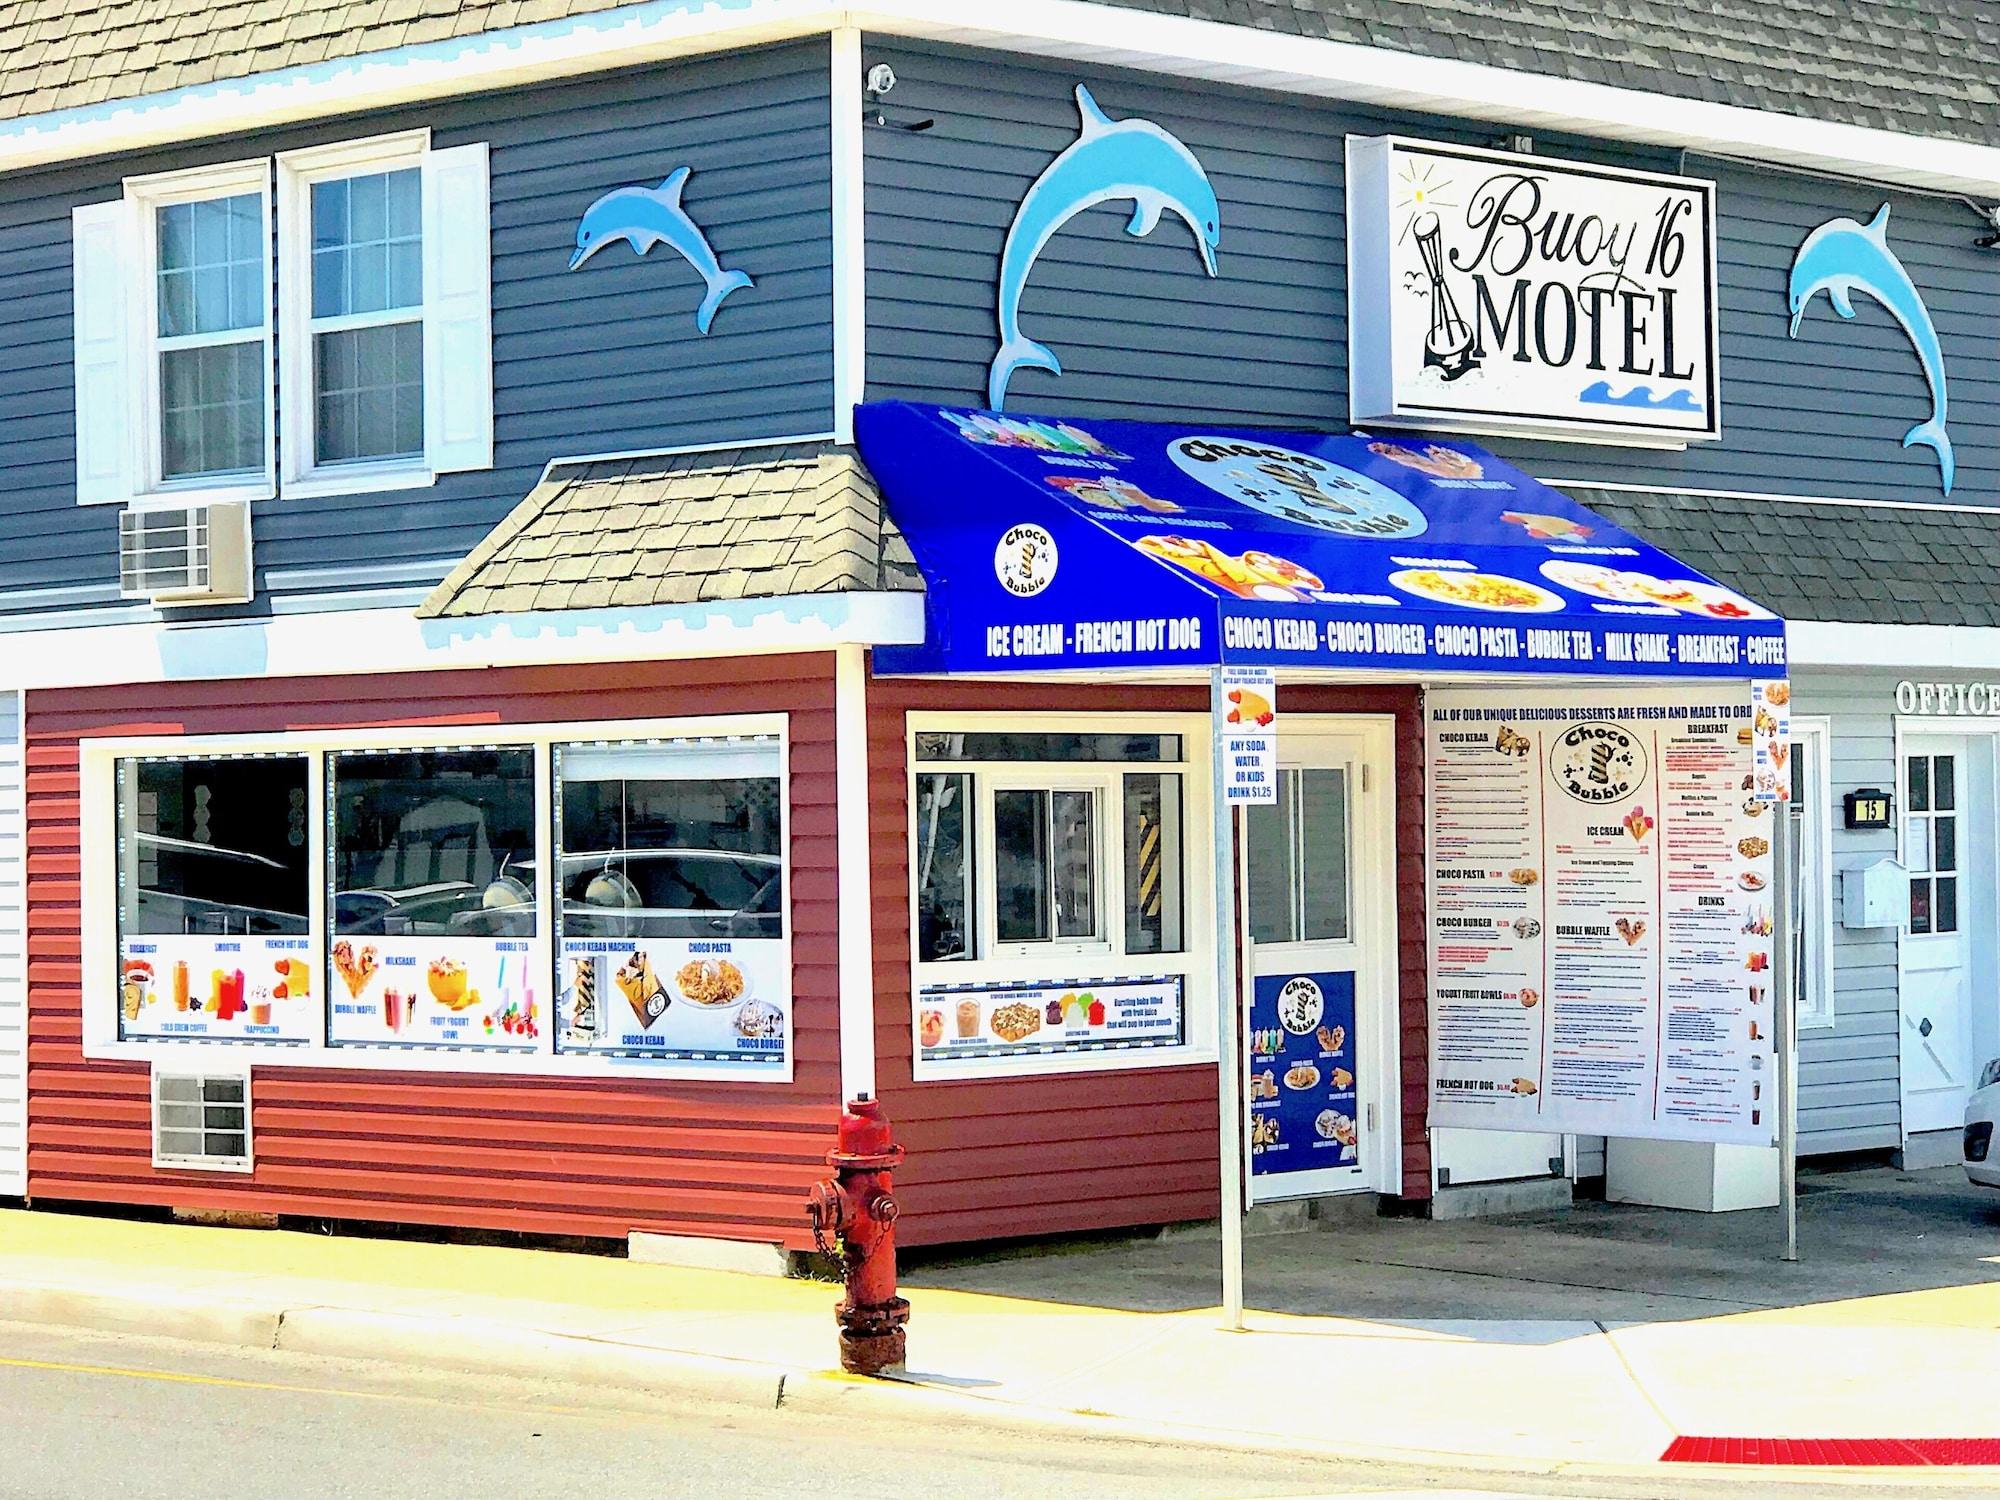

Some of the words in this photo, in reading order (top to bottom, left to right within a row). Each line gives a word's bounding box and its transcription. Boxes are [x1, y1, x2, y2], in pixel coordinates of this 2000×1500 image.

[1449, 173, 1646, 292] Buoy
[1645, 197, 1692, 278] 16
[1471, 273, 1695, 381] MOTEL
[1180, 440, 1327, 472] Choco
[1005, 528, 1047, 546] Choco
[1006, 576, 1046, 594] Bubble
[986, 625, 1011, 657] ICE
[1013, 623, 1063, 656] CREAM
[1075, 620, 1133, 654] FRENCH
[1135, 618, 1167, 652] HOT
[1168, 616, 1201, 650] DOG
[1224, 616, 1273, 650] CHOCO
[1273, 618, 1319, 651] KEBAB
[1327, 621, 1373, 653] CHOCO
[1374, 623, 1427, 655] BURGER
[1435, 624, 1478, 656] CHOCO
[1480, 627, 1519, 658] PASTA
[1527, 629, 1571, 660] BUBBLE
[1572, 631, 1594, 661] TEA
[1604, 632, 1634, 662] MILK
[1634, 633, 1671, 663] SHAKE
[1677, 634, 1740, 664] BREAKFAST
[1746, 636, 1785, 665] COFFEE
[1895, 680, 2000, 715] OFFICE
[1433, 708, 1449, 721] ALL
[1450, 708, 1460, 721] OF
[1462, 708, 1482, 721] OUR
[1484, 708, 1518, 722] UNIQUE
[1519, 707, 1568, 721] DELICIOUS
[1569, 706, 1616, 720] DESSERTS
[1617, 706, 1635, 720] ARE
[1637, 706, 1667, 720] FRESH
[1668, 706, 1688, 719] AND
[1690, 705, 1717, 719] MADE
[1719, 705, 1731, 718] TO
[1687, 723, 1729, 734] BREAKFAST
[1439, 732, 1465, 743] CHOCO
[1465, 732, 1489, 743] KEBAB
[1565, 726, 1630, 747] Choco
[1230, 740, 1244, 751] ANY
[1235, 771, 1246, 782] OR
[1247, 771, 1265, 782] KIDS
[1228, 786, 1250, 798] DRINK
[1568, 781, 1629, 800] Bubble
[1865, 801, 1877, 821] 15
[1587, 826, 1599, 836] ICE
[1599, 826, 1625, 836] CREAM
[1436, 869, 1462, 879] CHOCO
[1463, 869, 1486, 879] PASTA
[1698, 896, 1725, 906] DRINKS
[1436, 917, 1462, 927] CHOCO
[1463, 918, 1492, 927] BURGER
[1555, 925, 1583, 935] BUBBLE
[1584, 925, 1611, 936] WAFFLE
[495, 941, 517, 952] BUBBLE
[517, 941, 529, 952] TEA
[565, 941, 587, 952] CHOCO
[587, 941, 607, 952] KEBAB
[607, 942, 636, 952] MACHINE
[688, 942, 711, 953] CHOCO
[711, 942, 732, 953] PASTA
[1285, 981, 1316, 996] Choco
[622, 1034, 643, 1045] CHOCO
[644, 1035, 665, 1046] KEBAB
[736, 1038, 759, 1048] CHOCO
[1436, 1079, 1463, 1089] FRENCH
[1464, 1080, 1478, 1090] HOT
[1479, 1080, 1494, 1091] DOG
